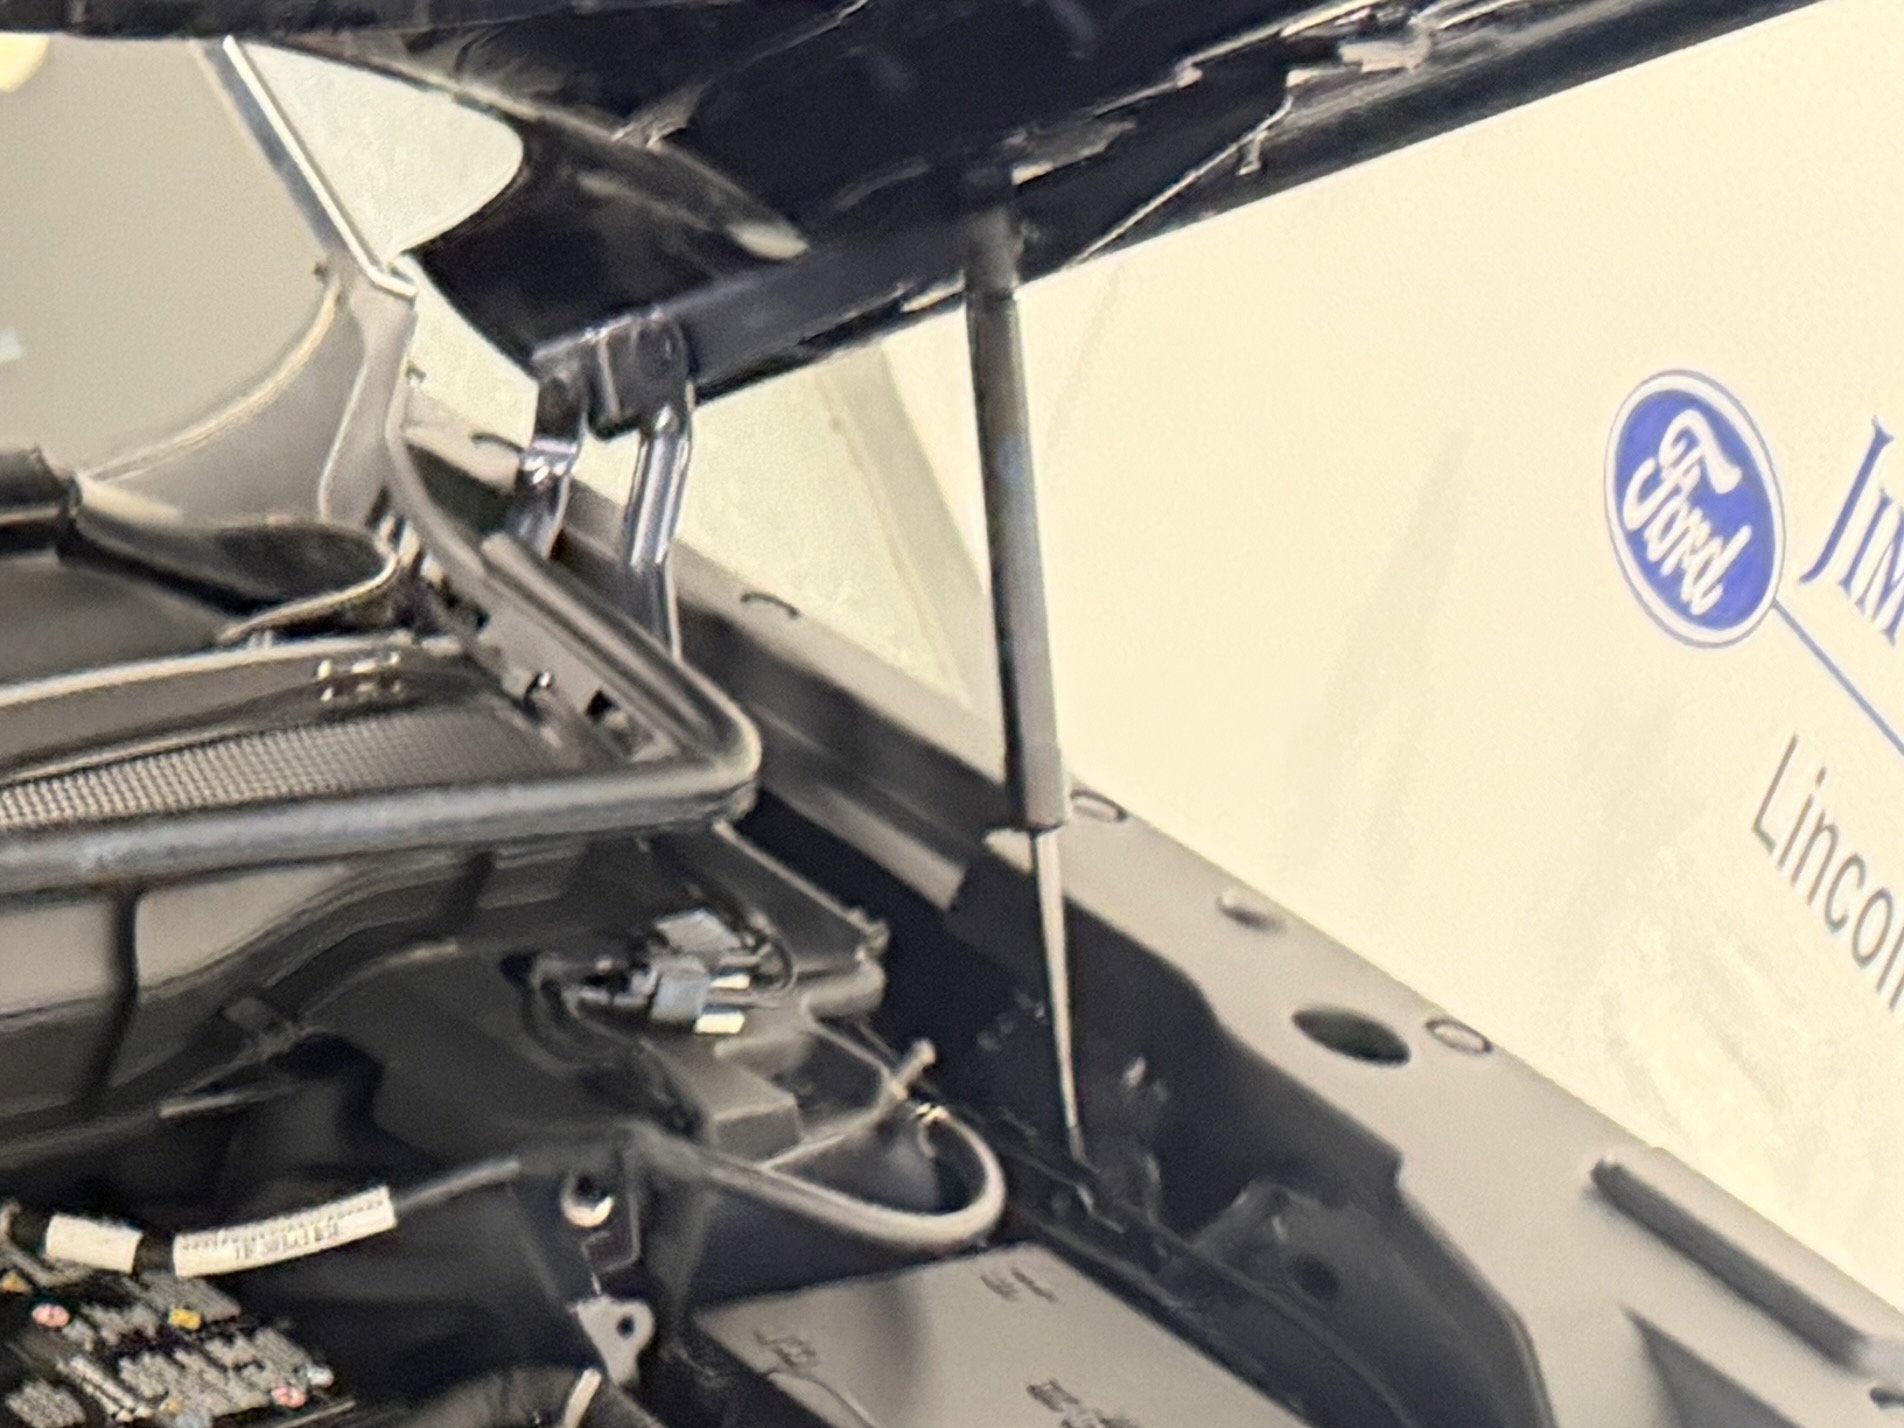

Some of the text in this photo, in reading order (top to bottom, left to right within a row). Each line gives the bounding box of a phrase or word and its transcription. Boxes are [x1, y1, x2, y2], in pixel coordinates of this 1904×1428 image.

[1624, 409, 1750, 614] Ford
[1798, 415, 1904, 647] JIM
[1752, 733, 1904, 1011] Lincol
